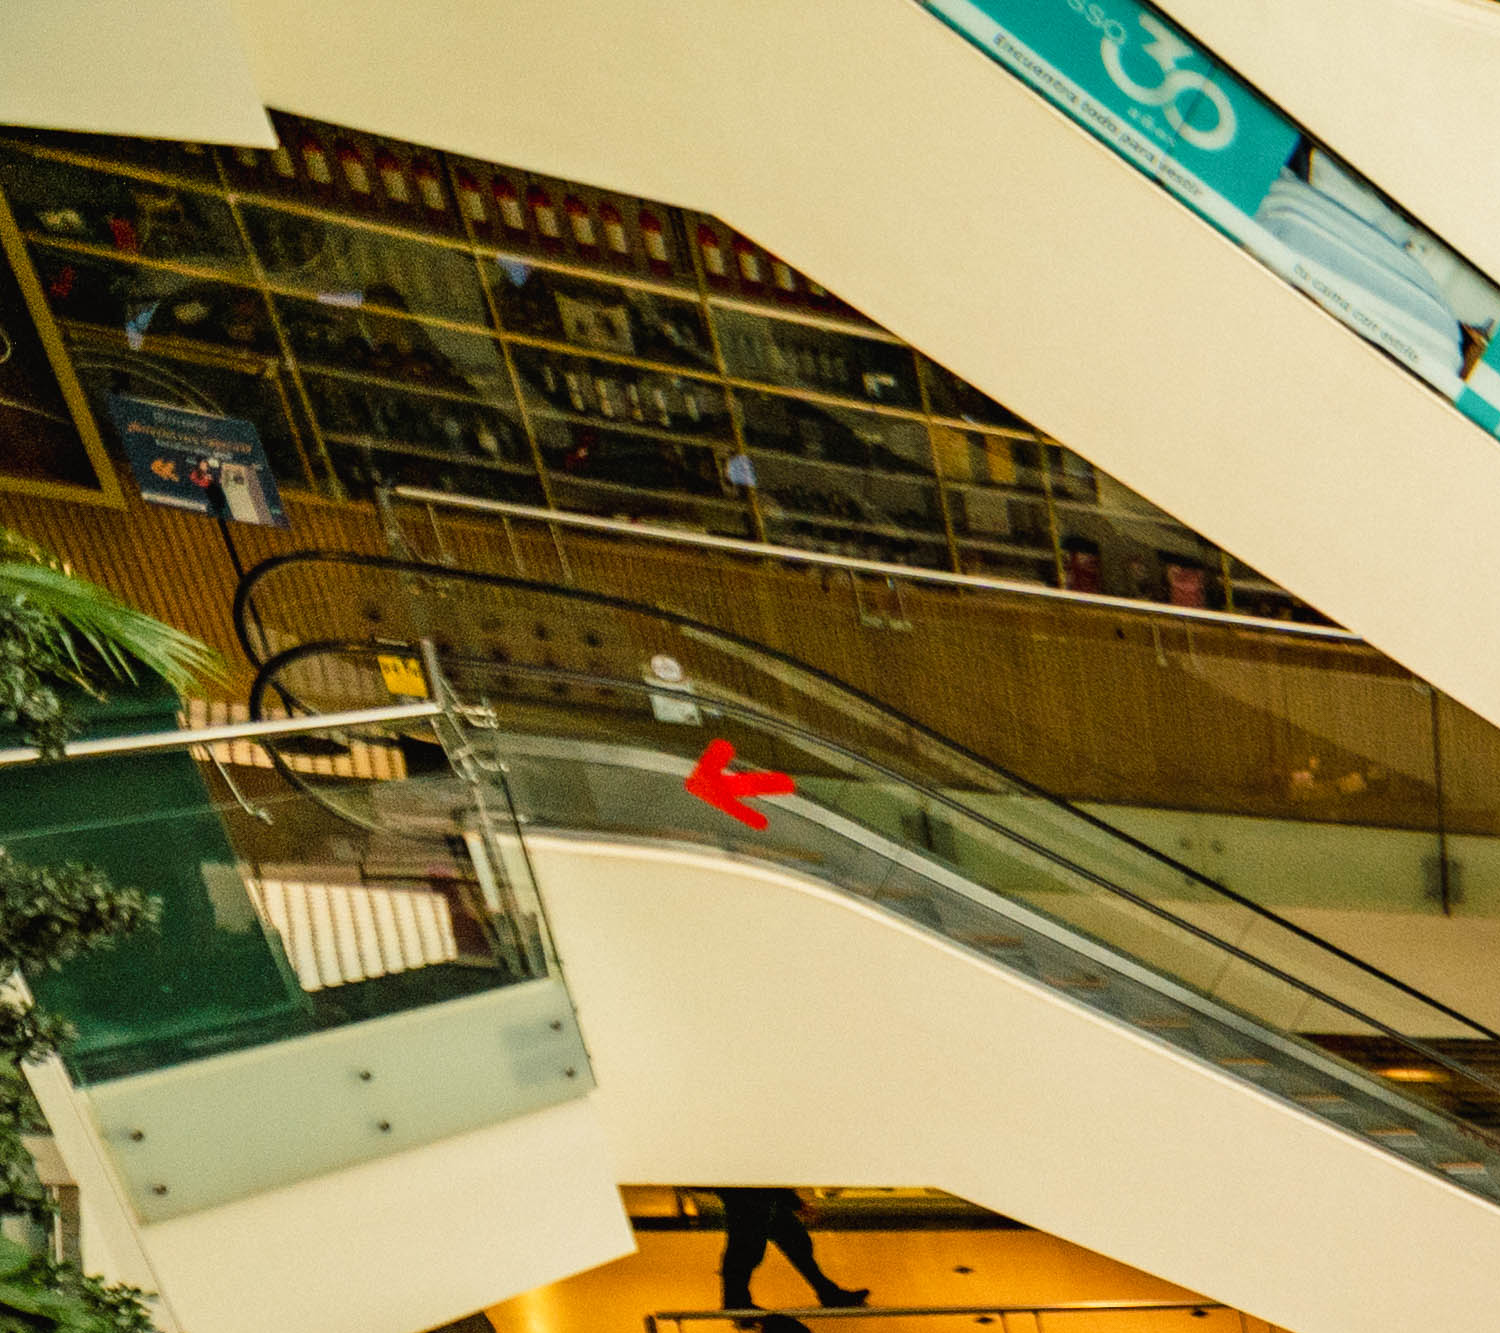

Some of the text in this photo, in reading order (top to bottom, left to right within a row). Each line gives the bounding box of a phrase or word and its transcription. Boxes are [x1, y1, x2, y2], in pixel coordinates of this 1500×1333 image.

[991, 32, 1079, 103] Encuentra
[1079, 98, 1119, 134] todo
[1119, 130, 1156, 163] para
